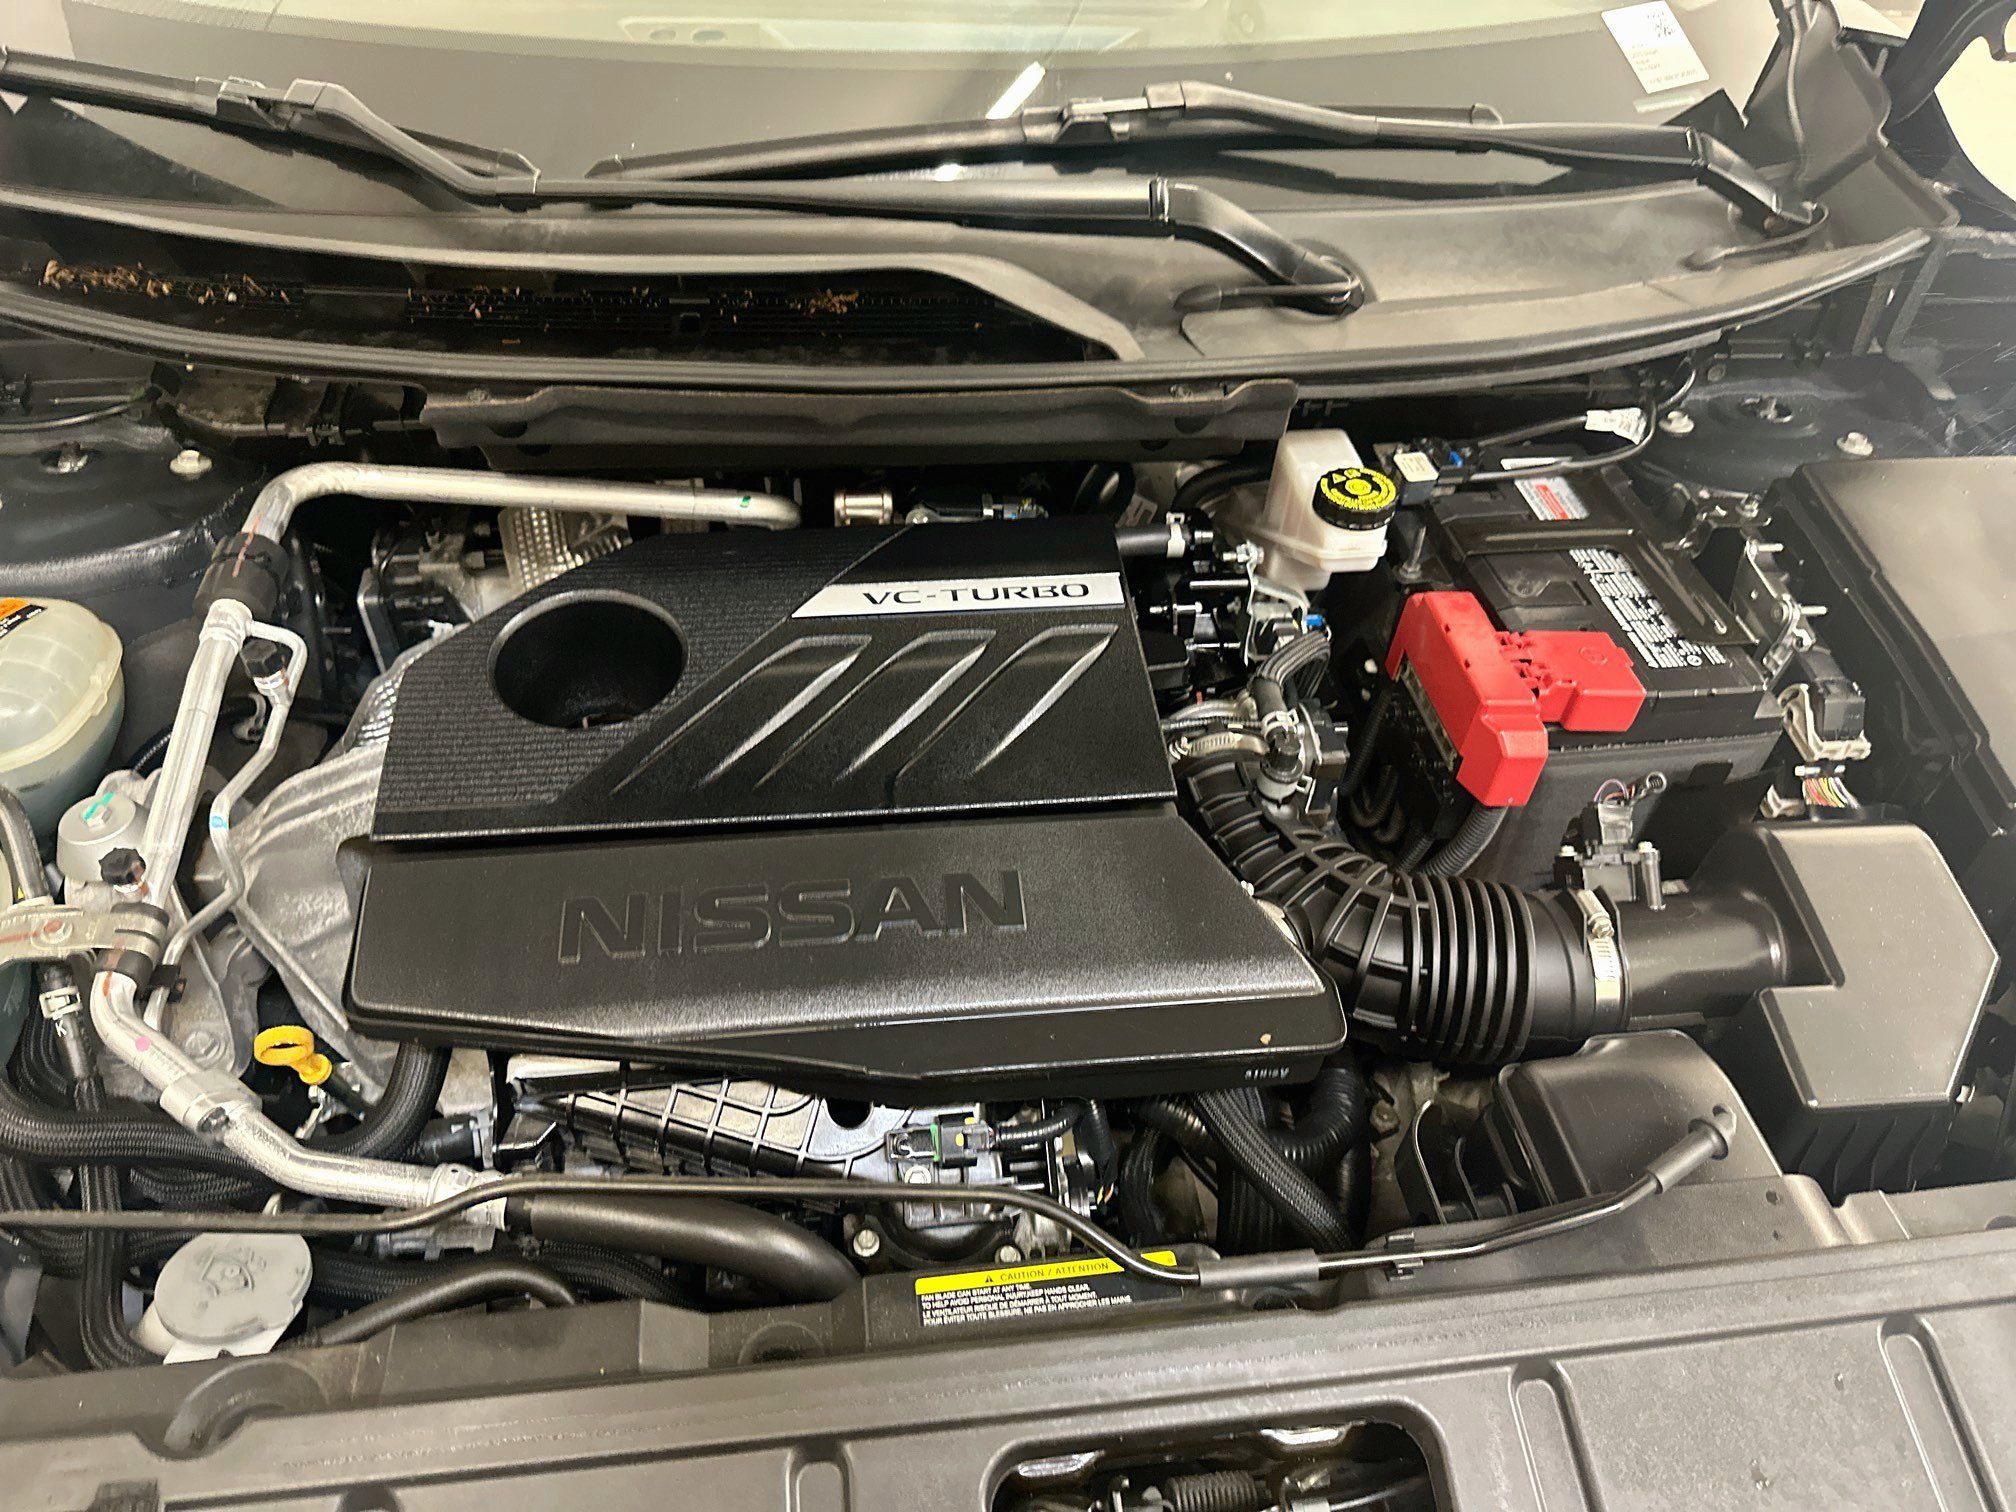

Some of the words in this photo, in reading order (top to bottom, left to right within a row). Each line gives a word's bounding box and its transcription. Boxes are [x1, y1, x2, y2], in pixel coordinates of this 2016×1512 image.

[862, 582, 1090, 605] VC-TURBO
[558, 870, 1027, 963] NISSAN
[1000, 1270, 1044, 1281] CAUTION
[1055, 1262, 1109, 1275] ATTENTION
[922, 1302, 931, 1310] TO
[932, 1300, 949, 1308] HELP
[970, 1293, 1005, 1304] PERSONAL
[1044, 1286, 1067, 1296] HANDS
[935, 1291, 956, 1300] BLADE
[957, 1289, 971, 1298] CAN
[972, 1286, 992, 1296] START
[992, 1285, 1001, 1294] AT
[1001, 1284, 1015, 1293] ANY
[922, 1310, 931, 1318] LE
[998, 1301, 1008, 1310] DE
[1051, 1293, 1067, 1303] TOUT
[966, 1312, 987, 1321] TOUTE
[1034, 1305, 1047, 1314] PAS
[1097, 1297, 1110, 1306] LES
